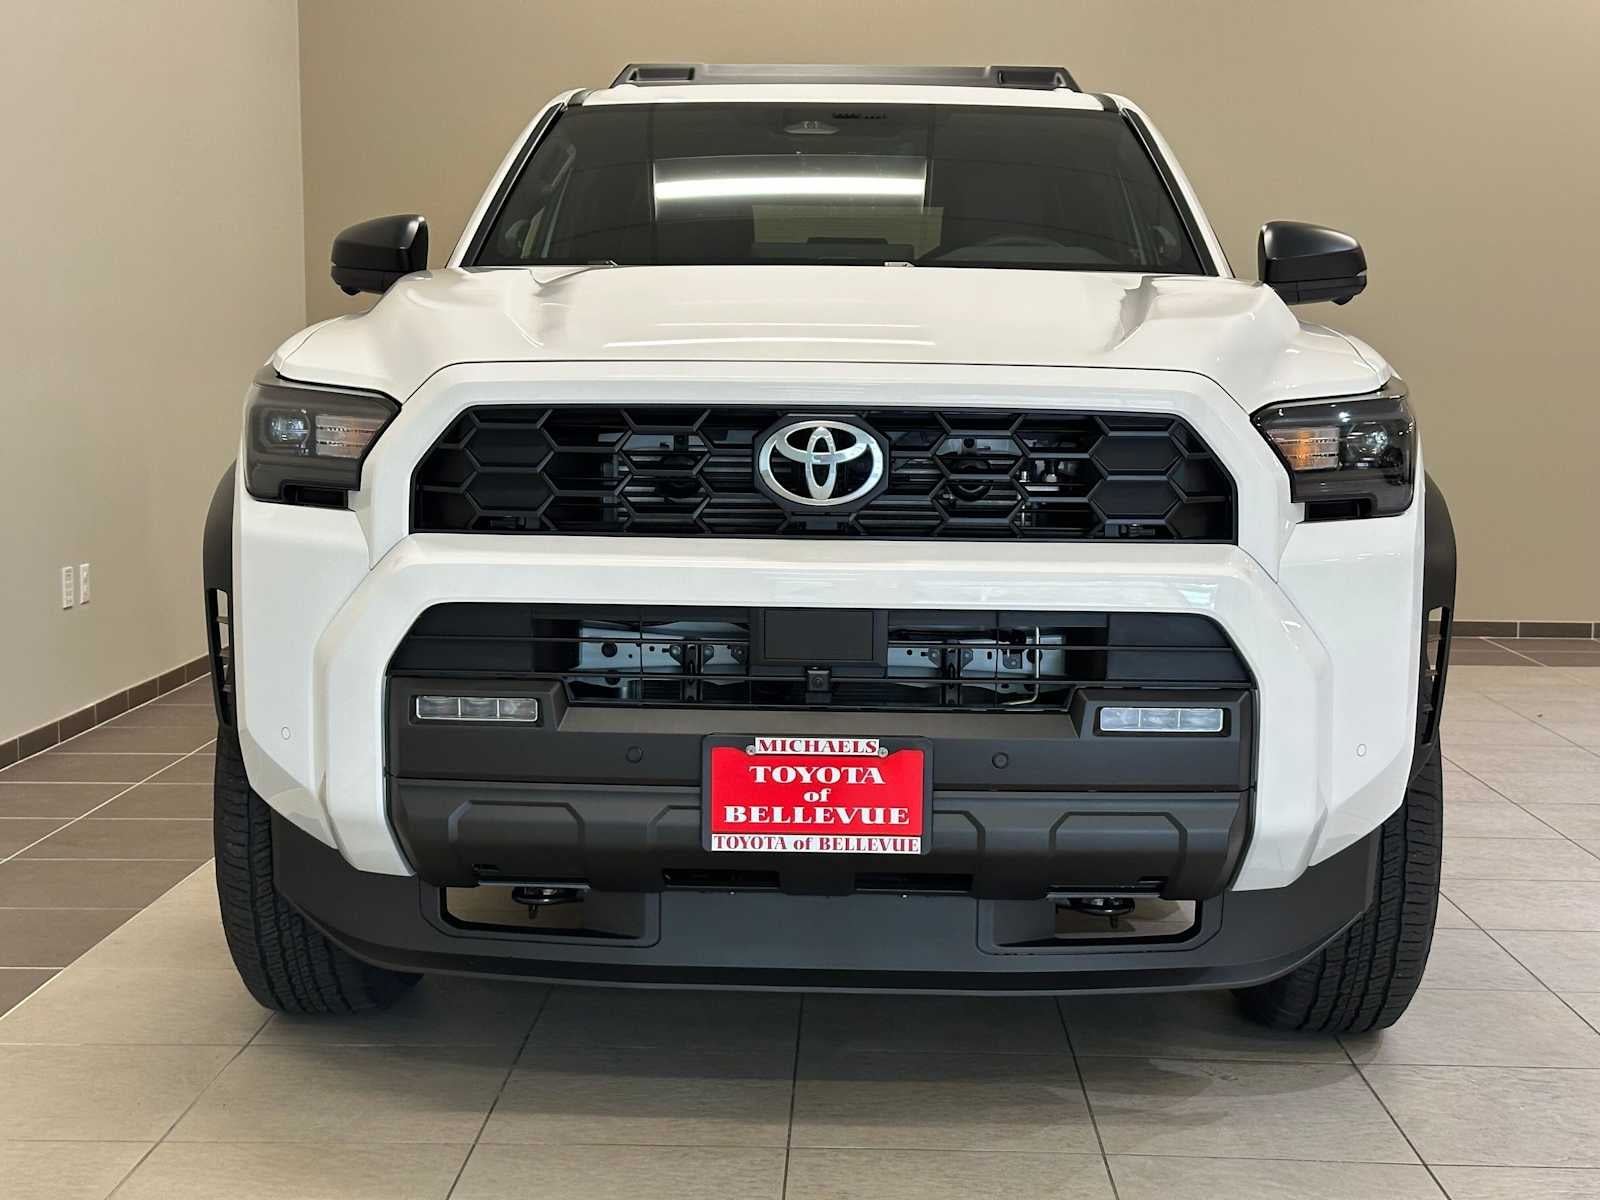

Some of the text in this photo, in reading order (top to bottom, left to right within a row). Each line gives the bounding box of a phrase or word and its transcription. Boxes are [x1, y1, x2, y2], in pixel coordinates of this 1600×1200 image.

[758, 739, 878, 754] MICHAELS
[749, 765, 885, 784] TOYOTA
[803, 788, 831, 802] of
[724, 806, 910, 824] BELLEVUE
[714, 836, 919, 852] TOYOTA of BELLEVUE
